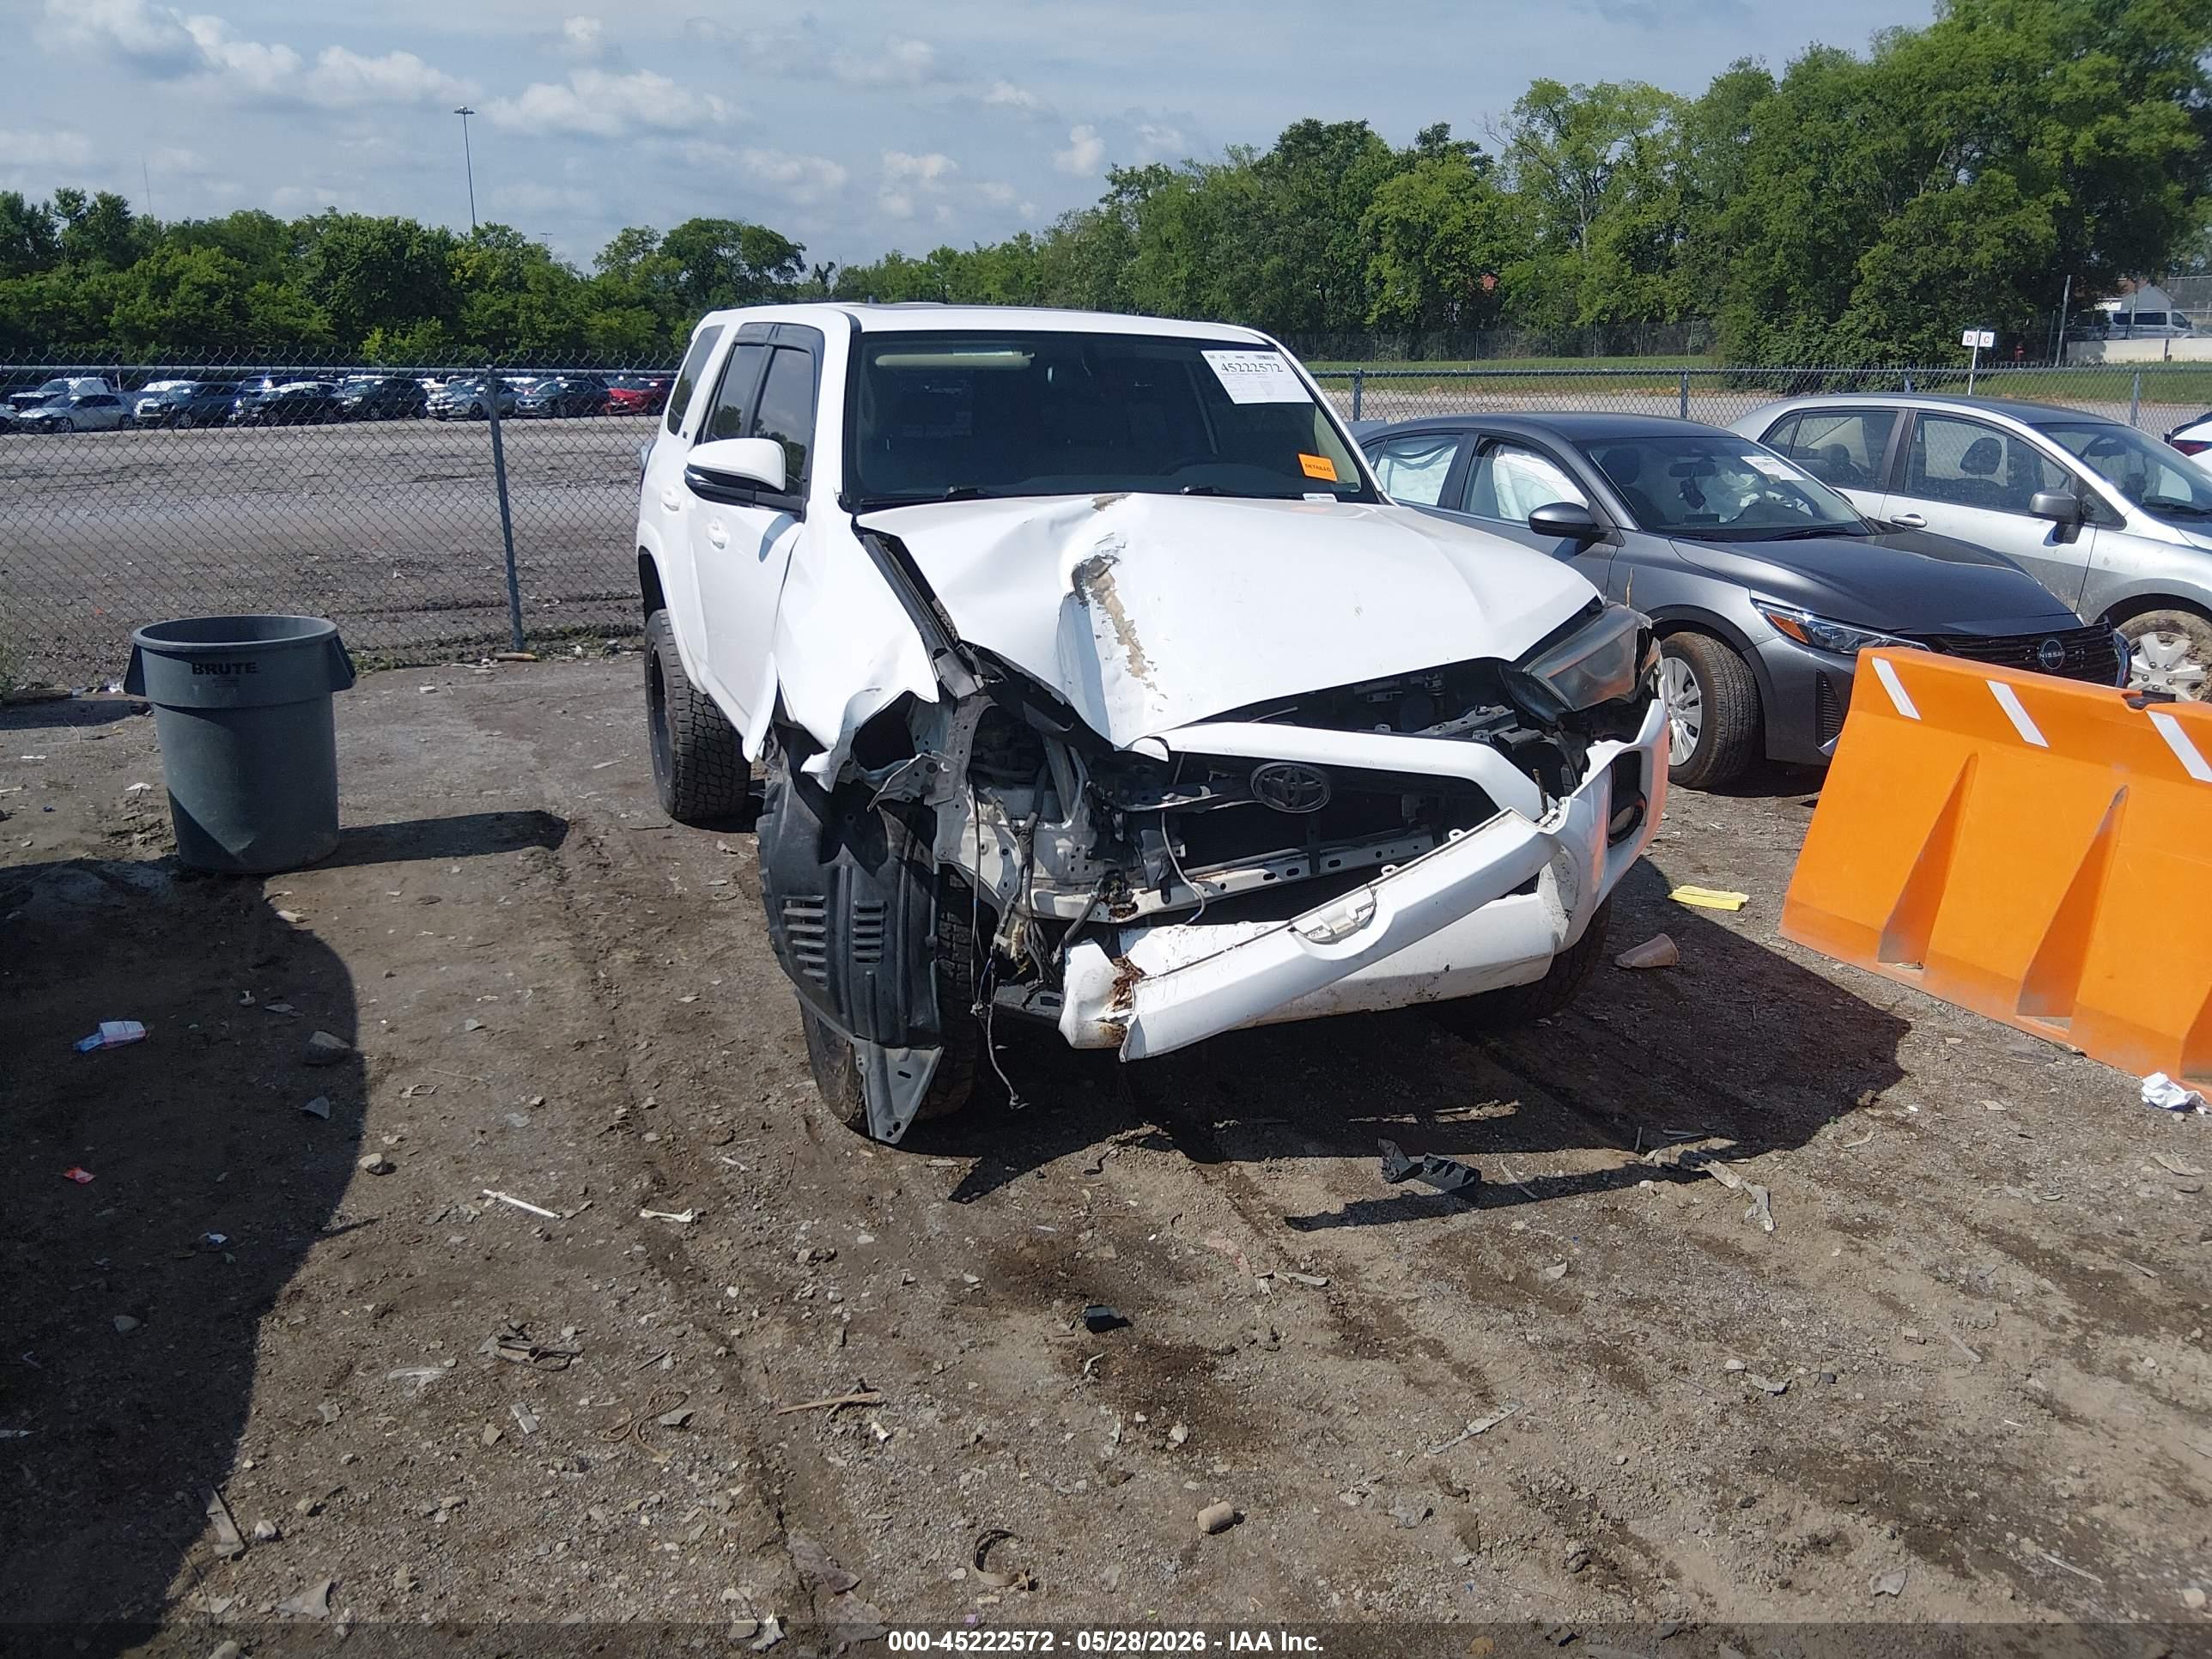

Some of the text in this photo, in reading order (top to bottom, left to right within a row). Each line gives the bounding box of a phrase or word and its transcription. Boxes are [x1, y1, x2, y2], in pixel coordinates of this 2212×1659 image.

[1966, 334, 1973, 343] D
[1220, 362, 1284, 373] 45222572
[2039, 649, 2066, 659] NISSAN
[191, 661, 259, 675] BRUTE
